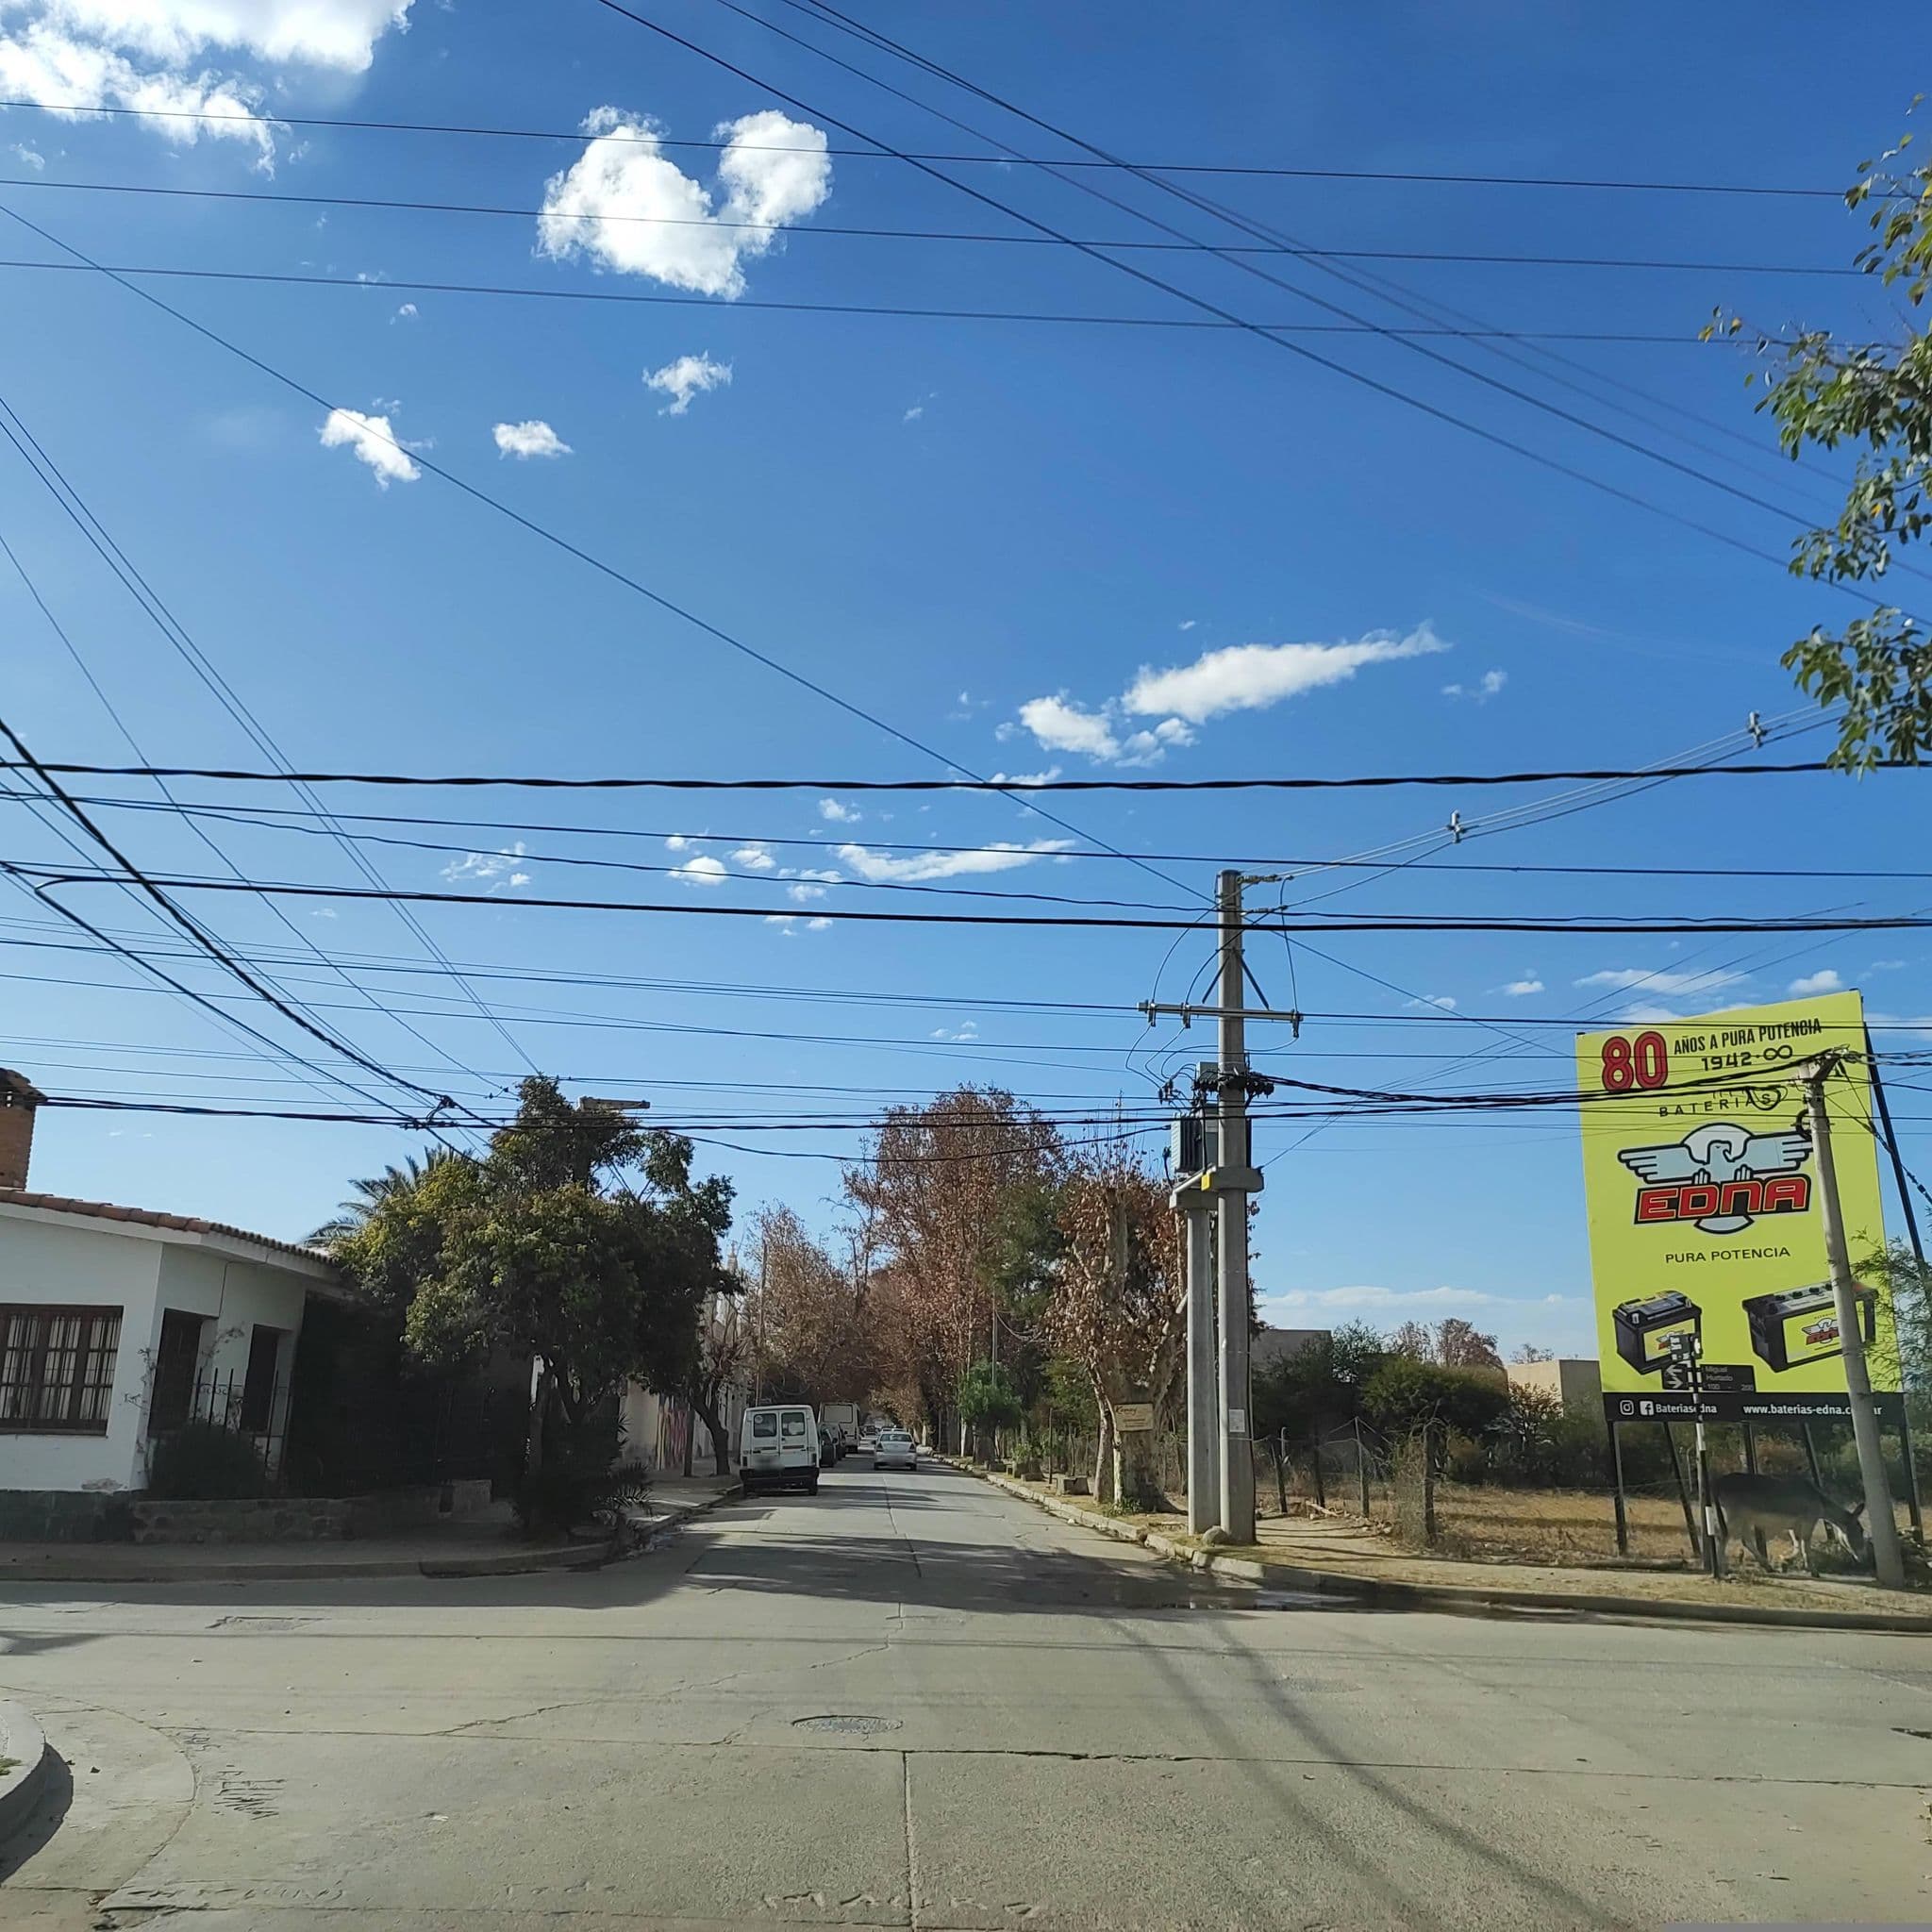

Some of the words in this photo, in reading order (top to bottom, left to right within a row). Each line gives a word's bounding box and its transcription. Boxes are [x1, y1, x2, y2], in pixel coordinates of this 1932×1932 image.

[1602, 1031, 1668, 1092] 80
[1674, 1035, 1706, 1055] AÑOS
[1709, 1034, 1718, 1050] A
[1722, 1028, 1755, 1047] PURA
[1759, 1018, 1822, 1041] POTENCIA
[1659, 1094, 1771, 1117] BATERIAS
[1638, 1177, 1808, 1221] EDNA
[1665, 1252, 1707, 1263] PURA
[1711, 1247, 1790, 1261] POTENCIA
